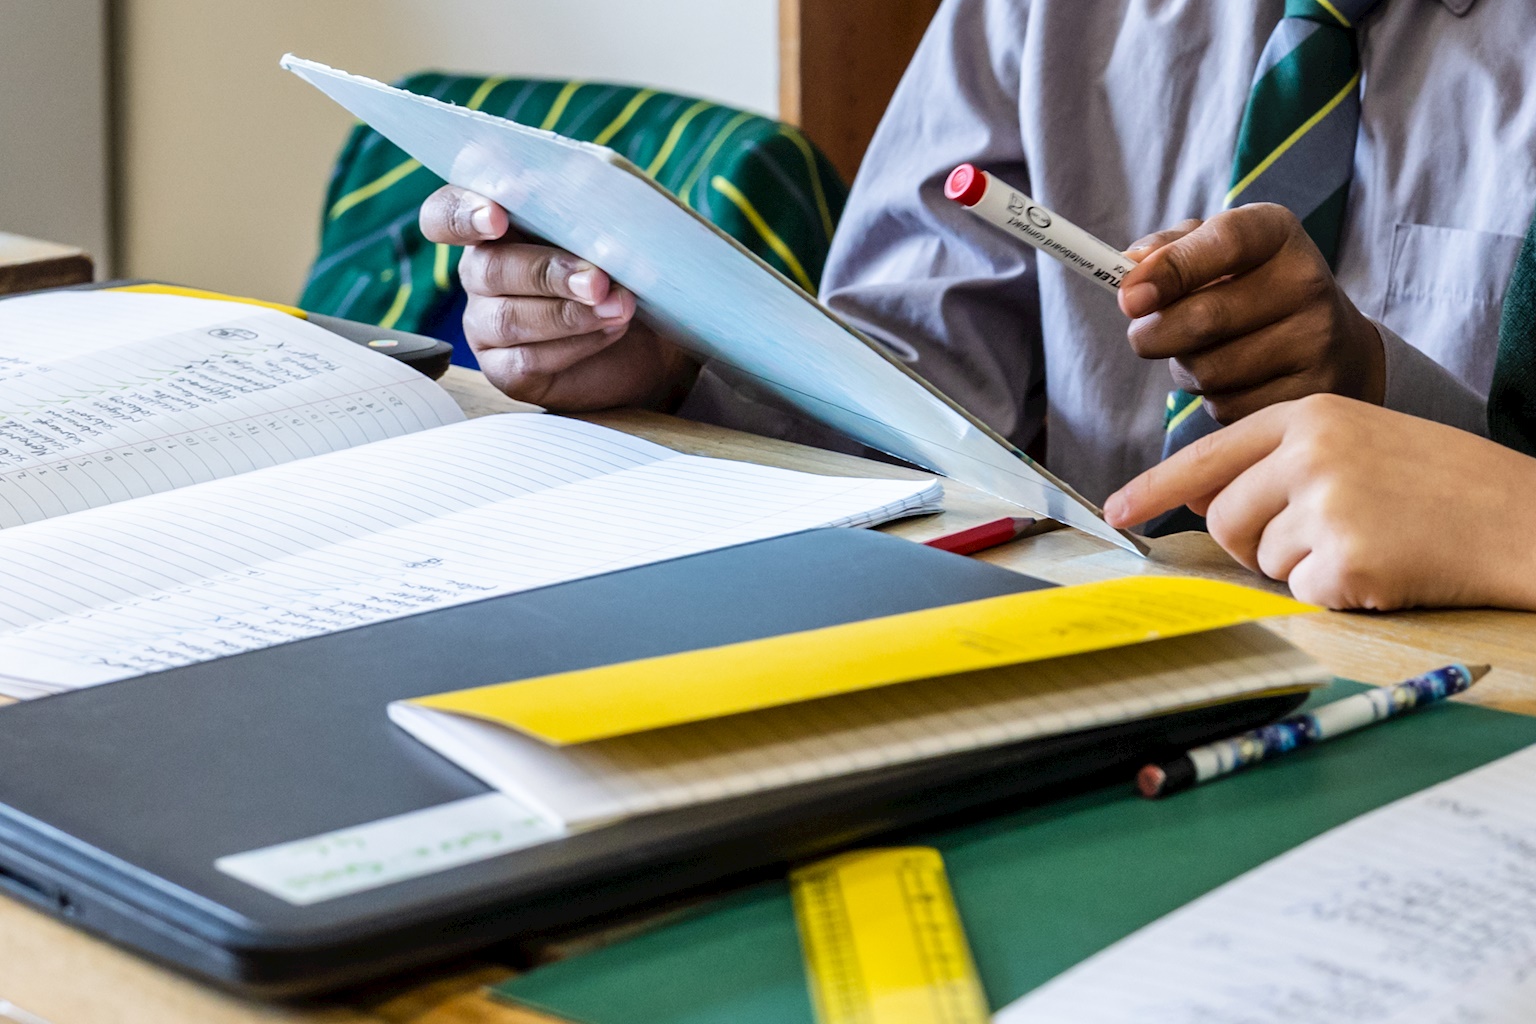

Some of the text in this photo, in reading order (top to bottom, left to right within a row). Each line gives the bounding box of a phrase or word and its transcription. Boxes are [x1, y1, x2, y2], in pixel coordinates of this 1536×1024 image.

[1006, 216, 1122, 288] TLER whiteboard compact
